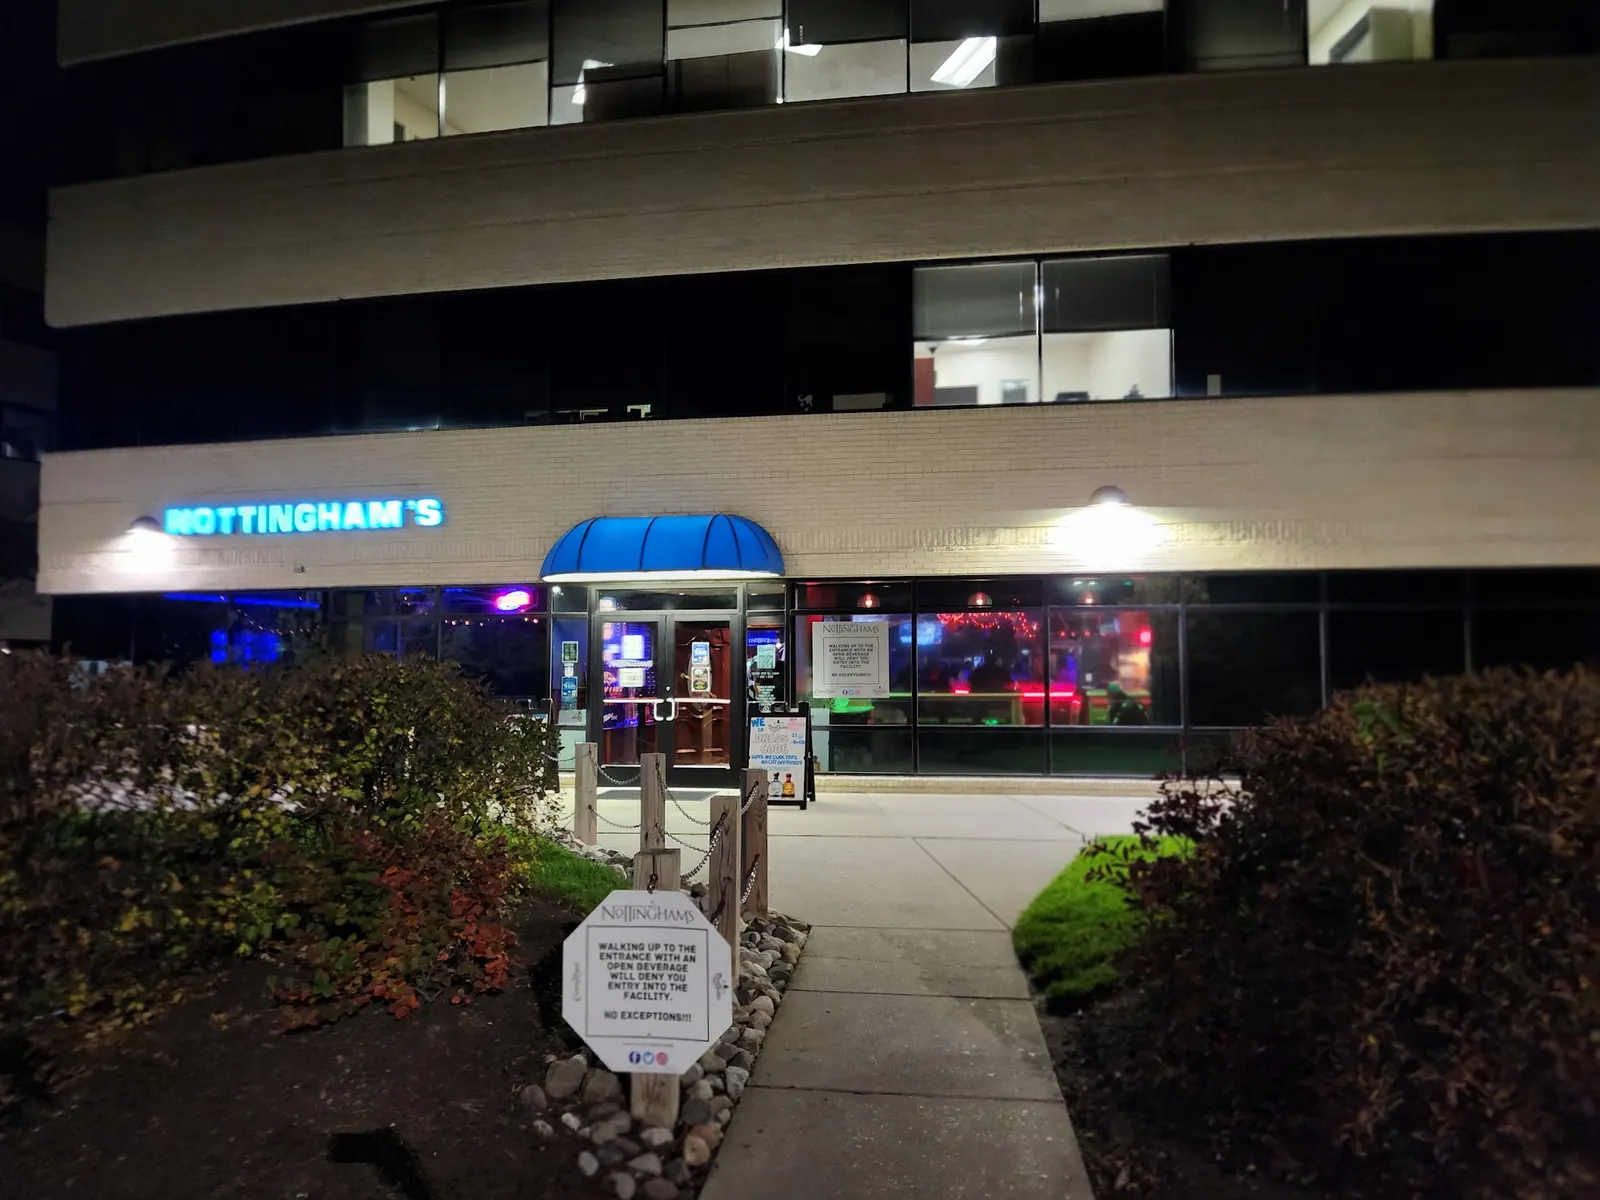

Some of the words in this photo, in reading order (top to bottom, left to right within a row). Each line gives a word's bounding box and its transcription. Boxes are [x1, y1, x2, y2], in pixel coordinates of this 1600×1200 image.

[164, 498, 442, 535] NOTTINGHAM'S
[752, 717, 765, 727] WE
[599, 943, 645, 951] WALKING
[648, 943, 661, 952] UP
[664, 943, 676, 952] TO
[678, 945, 696, 953] THE
[599, 952, 652, 961] ENTRANCE
[654, 953, 680, 962] WITH
[683, 955, 696, 963] AN
[607, 962, 634, 971] OPEN
[636, 963, 689, 972] BEVERAGE
[610, 972, 635, 980] WILL
[638, 972, 664, 981] DENY
[668, 974, 686, 982] YOU
[608, 982, 640, 990] ENTRY
[642, 982, 667, 991] INTO
[669, 983, 688, 992] THE
[623, 992, 673, 1001] FACILITY.
[604, 1011, 618, 1019] NO
[621, 1011, 692, 1022] EXCEPTIONS!!!
